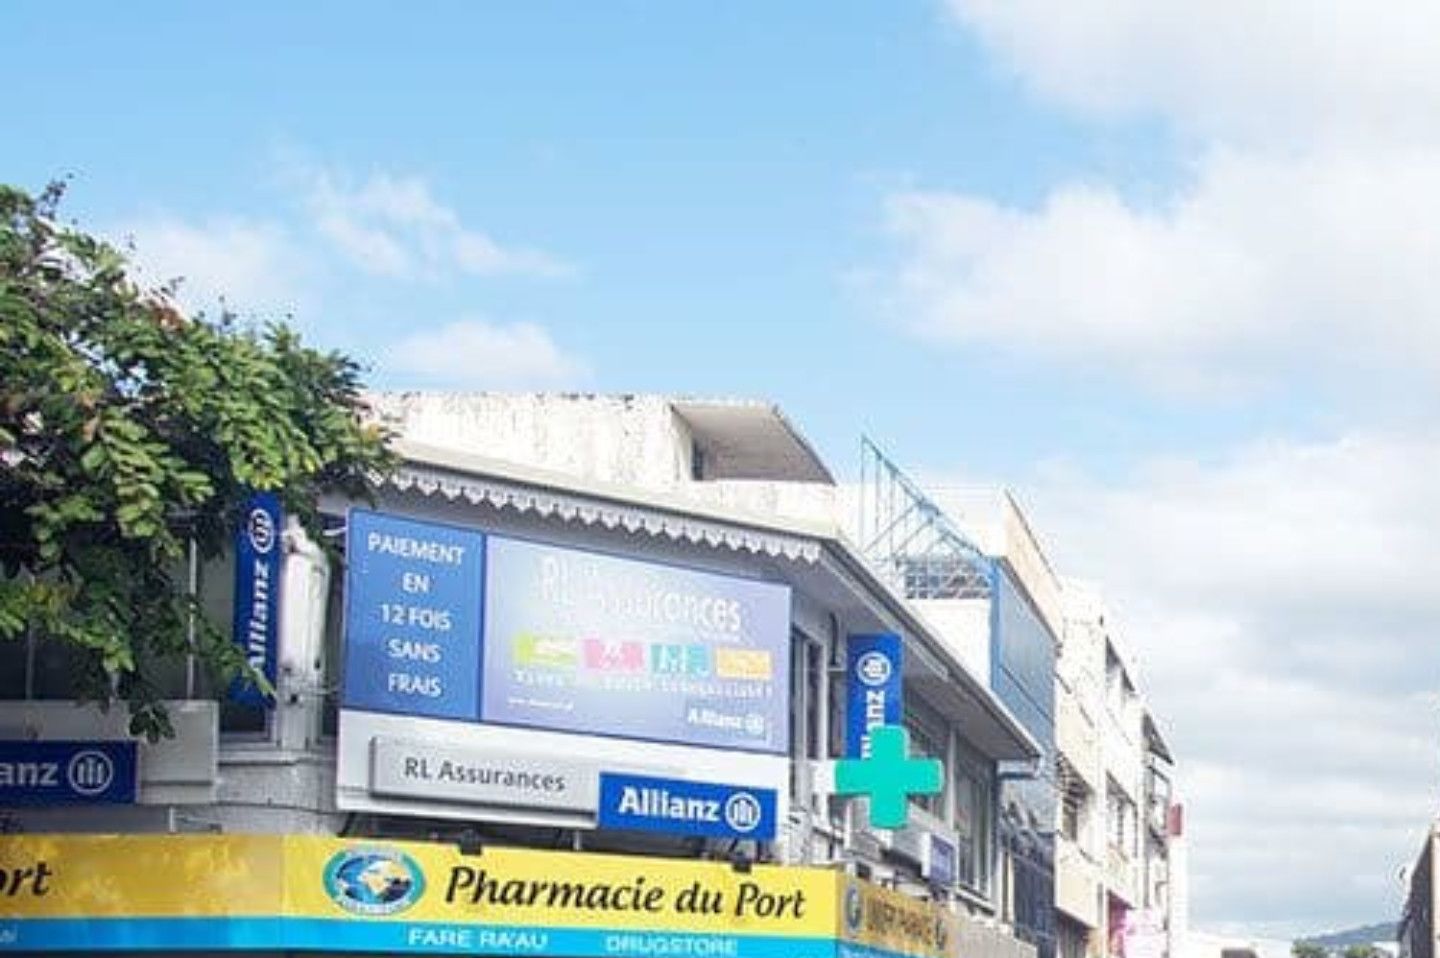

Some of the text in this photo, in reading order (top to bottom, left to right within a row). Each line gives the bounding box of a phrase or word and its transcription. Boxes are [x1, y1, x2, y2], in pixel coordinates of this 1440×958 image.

[367, 531, 464, 565] PAIEMENT
[401, 571, 430, 593] EN
[380, 603, 452, 630] 12 FOIS
[387, 638, 441, 663] SANS
[387, 672, 442, 698] FRAIS
[404, 757, 566, 792] RL Assurances
[618, 785, 720, 823] Allianz
[445, 865, 665, 913] Pharmacie
[674, 881, 724, 915] du
[735, 883, 807, 920] Port
[408, 927, 475, 947] FARE
[605, 934, 739, 956] DRUGSTORE
